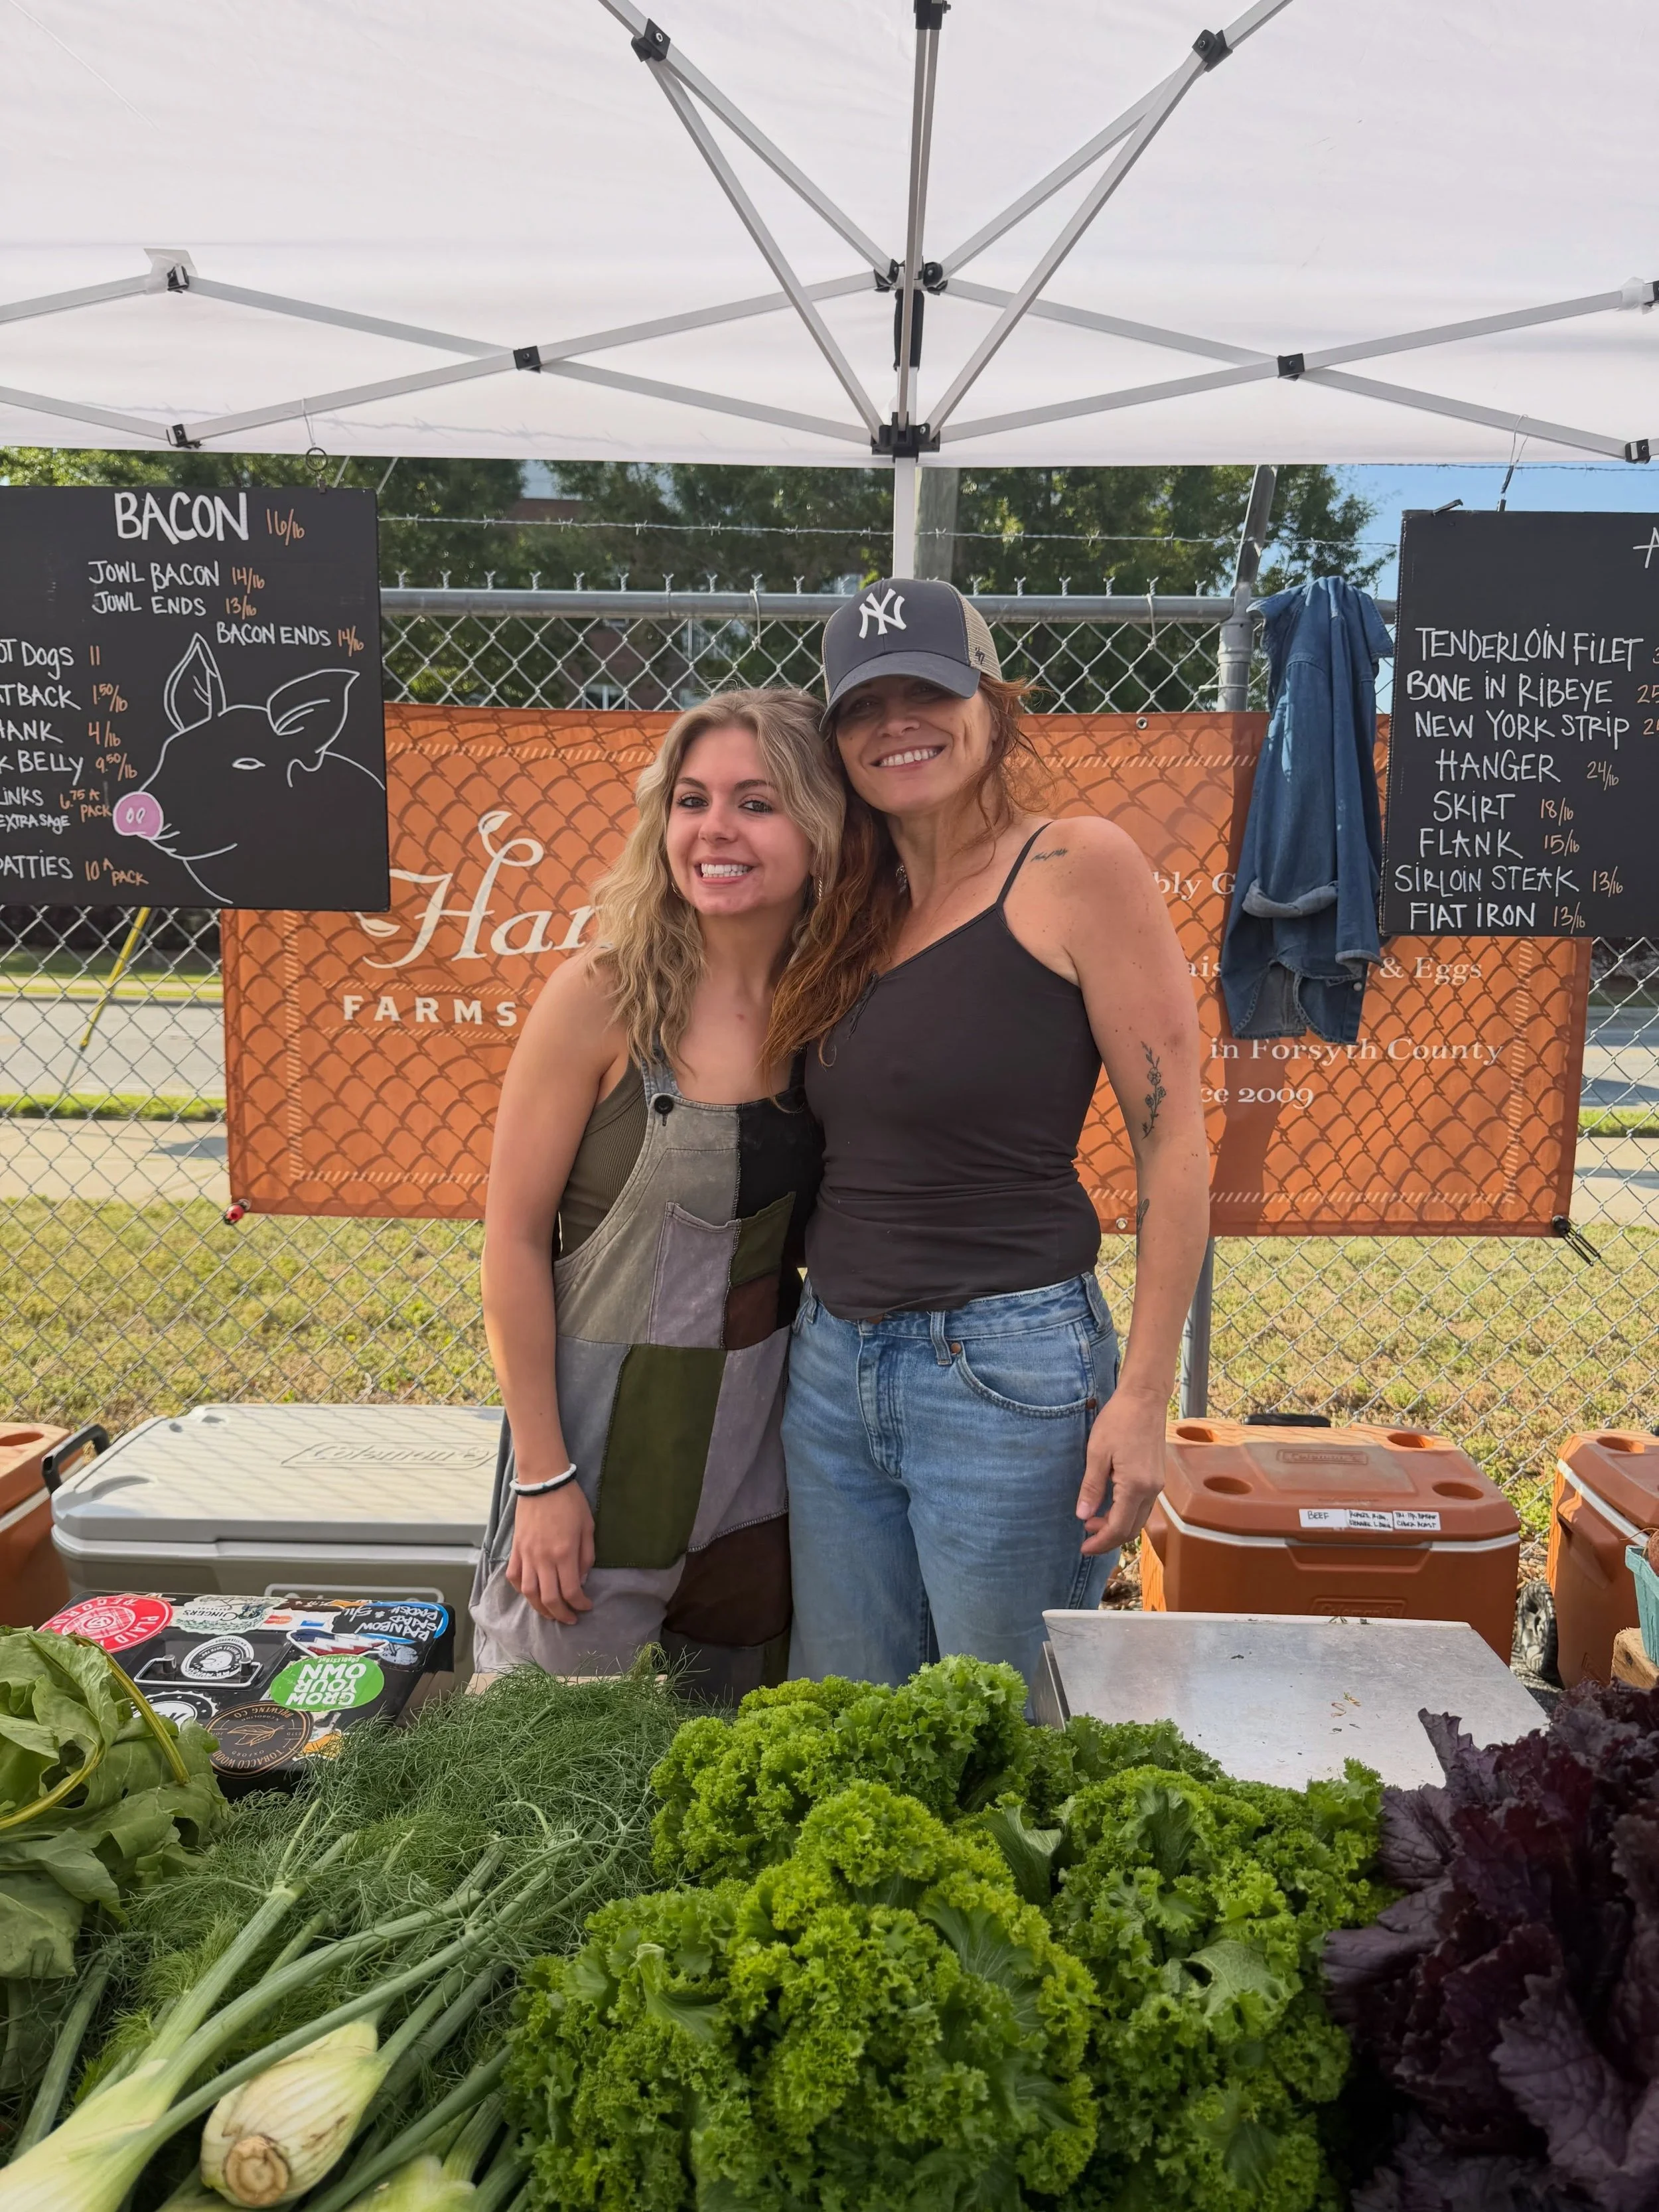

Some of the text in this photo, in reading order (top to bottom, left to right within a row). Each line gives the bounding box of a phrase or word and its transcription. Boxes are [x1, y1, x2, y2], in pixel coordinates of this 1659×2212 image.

[114, 491, 250, 544] BACON
[88, 559, 145, 585] JOWL
[151, 560, 220, 592] BACON
[92, 590, 142, 614] JOWL
[152, 595, 207, 617] ENDS
[859, 588, 906, 639] NY
[216, 621, 275, 646] BACON
[280, 625, 332, 646] ENDS
[1415, 623, 1565, 663] TENDERLOIN
[1573, 632, 1644, 672] FILET
[1407, 670, 1473, 702] BONE
[1485, 670, 1506, 700] IN
[1518, 671, 1613, 712] RIBEYE
[1415, 710, 1474, 739] NEW
[1486, 709, 1556, 743] YORK
[1561, 710, 1630, 751] STRIP
[17, 749, 84, 786] BELLY
[1435, 747, 1561, 783] HANGER
[80, 803, 112, 823] PACK
[1433, 789, 1516, 824] SKIRT
[1419, 827, 1524, 859] FLANK
[84, 860, 100, 882] 10
[111, 869, 149, 887] PACK
[1153, 871, 1203, 901] bly
[1394, 861, 1482, 897] SIRLOIN
[1491, 865, 1580, 897] STEAK
[356, 810, 607, 970] Har
[1477, 897, 1536, 928] IRON
[1379, 956, 1405, 979] &
[1414, 956, 1482, 986] Eggs
[342, 995, 518, 1027] FARMS
[1210, 1037, 1504, 1067] in Forsyth County
[1200, 1086, 1315, 1110] ce 2009
[1307, 1511, 1330, 1520] BEEF
[114, 1615, 161, 1645] PLAID
[182, 1609, 238, 1621] GINGER'S
[354, 1621, 430, 1643] RAINBOW
[293, 1678, 357, 1693] YOUR
[299, 1663, 367, 1679] OWN
[252, 1707, 295, 1719] BREWING
[285, 1692, 356, 1706] GROW
[237, 1749, 285, 1769] TOBACCO
